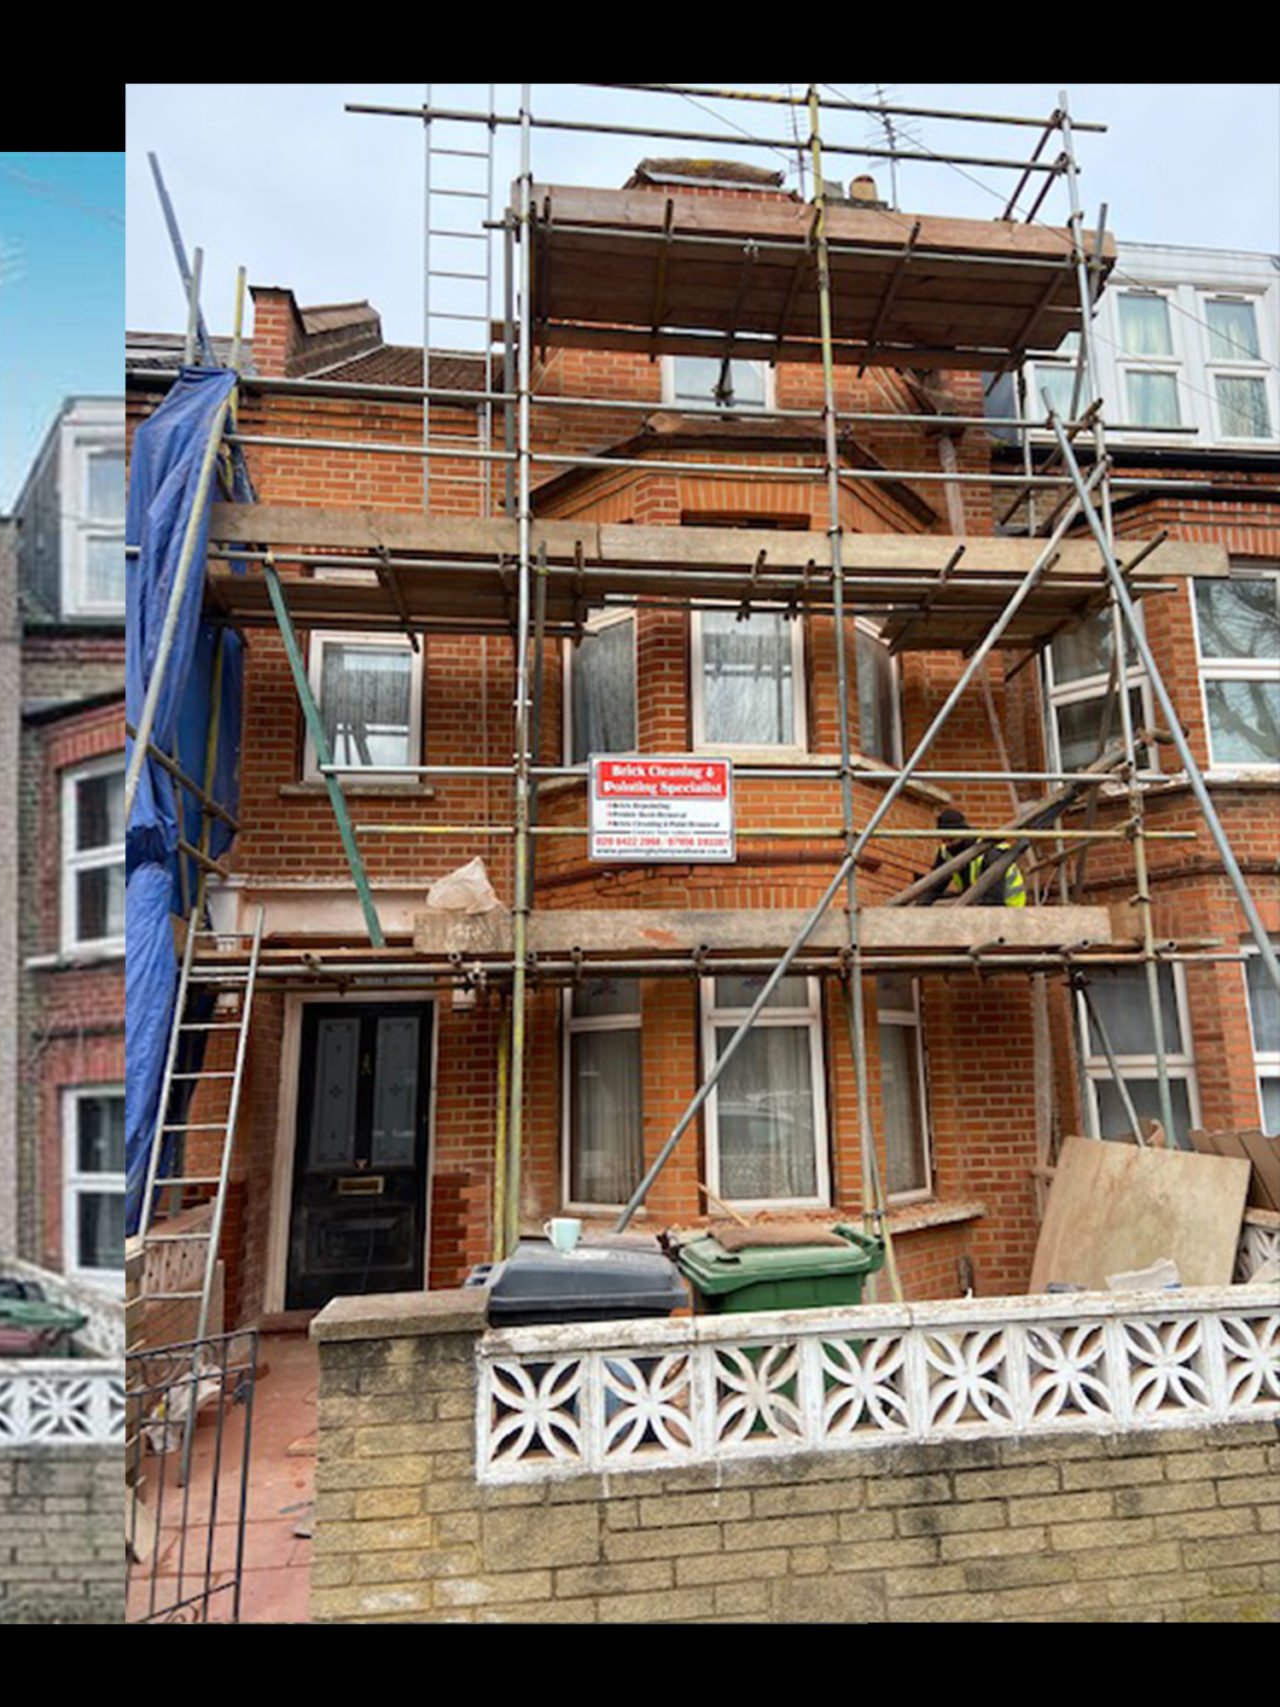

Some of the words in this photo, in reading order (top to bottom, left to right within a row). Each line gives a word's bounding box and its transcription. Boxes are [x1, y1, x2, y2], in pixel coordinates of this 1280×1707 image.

[611, 764, 646, 777] Brick
[648, 765, 703, 780] Cleaning
[603, 781, 657, 796] Pointing
[659, 781, 722, 797] Specialist
